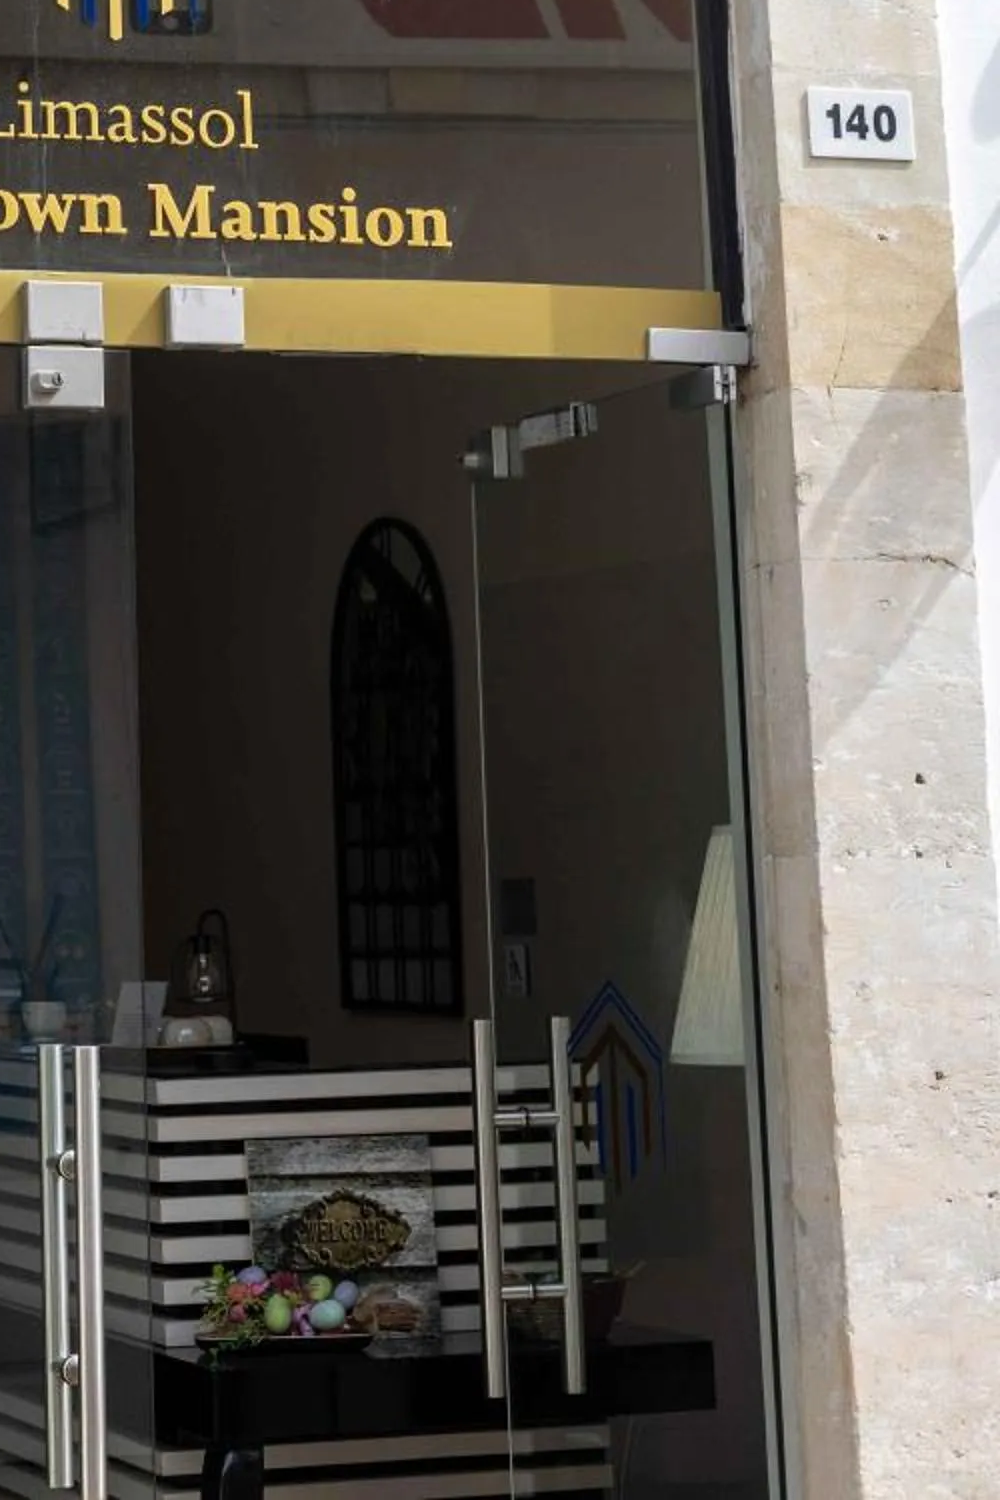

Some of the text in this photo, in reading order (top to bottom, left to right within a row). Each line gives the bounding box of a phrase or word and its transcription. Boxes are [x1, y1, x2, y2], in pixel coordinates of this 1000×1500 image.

[825, 103, 897, 142] 140
[149, 184, 453, 249] Mansion
[307, 1219, 388, 1243] WELCOME
